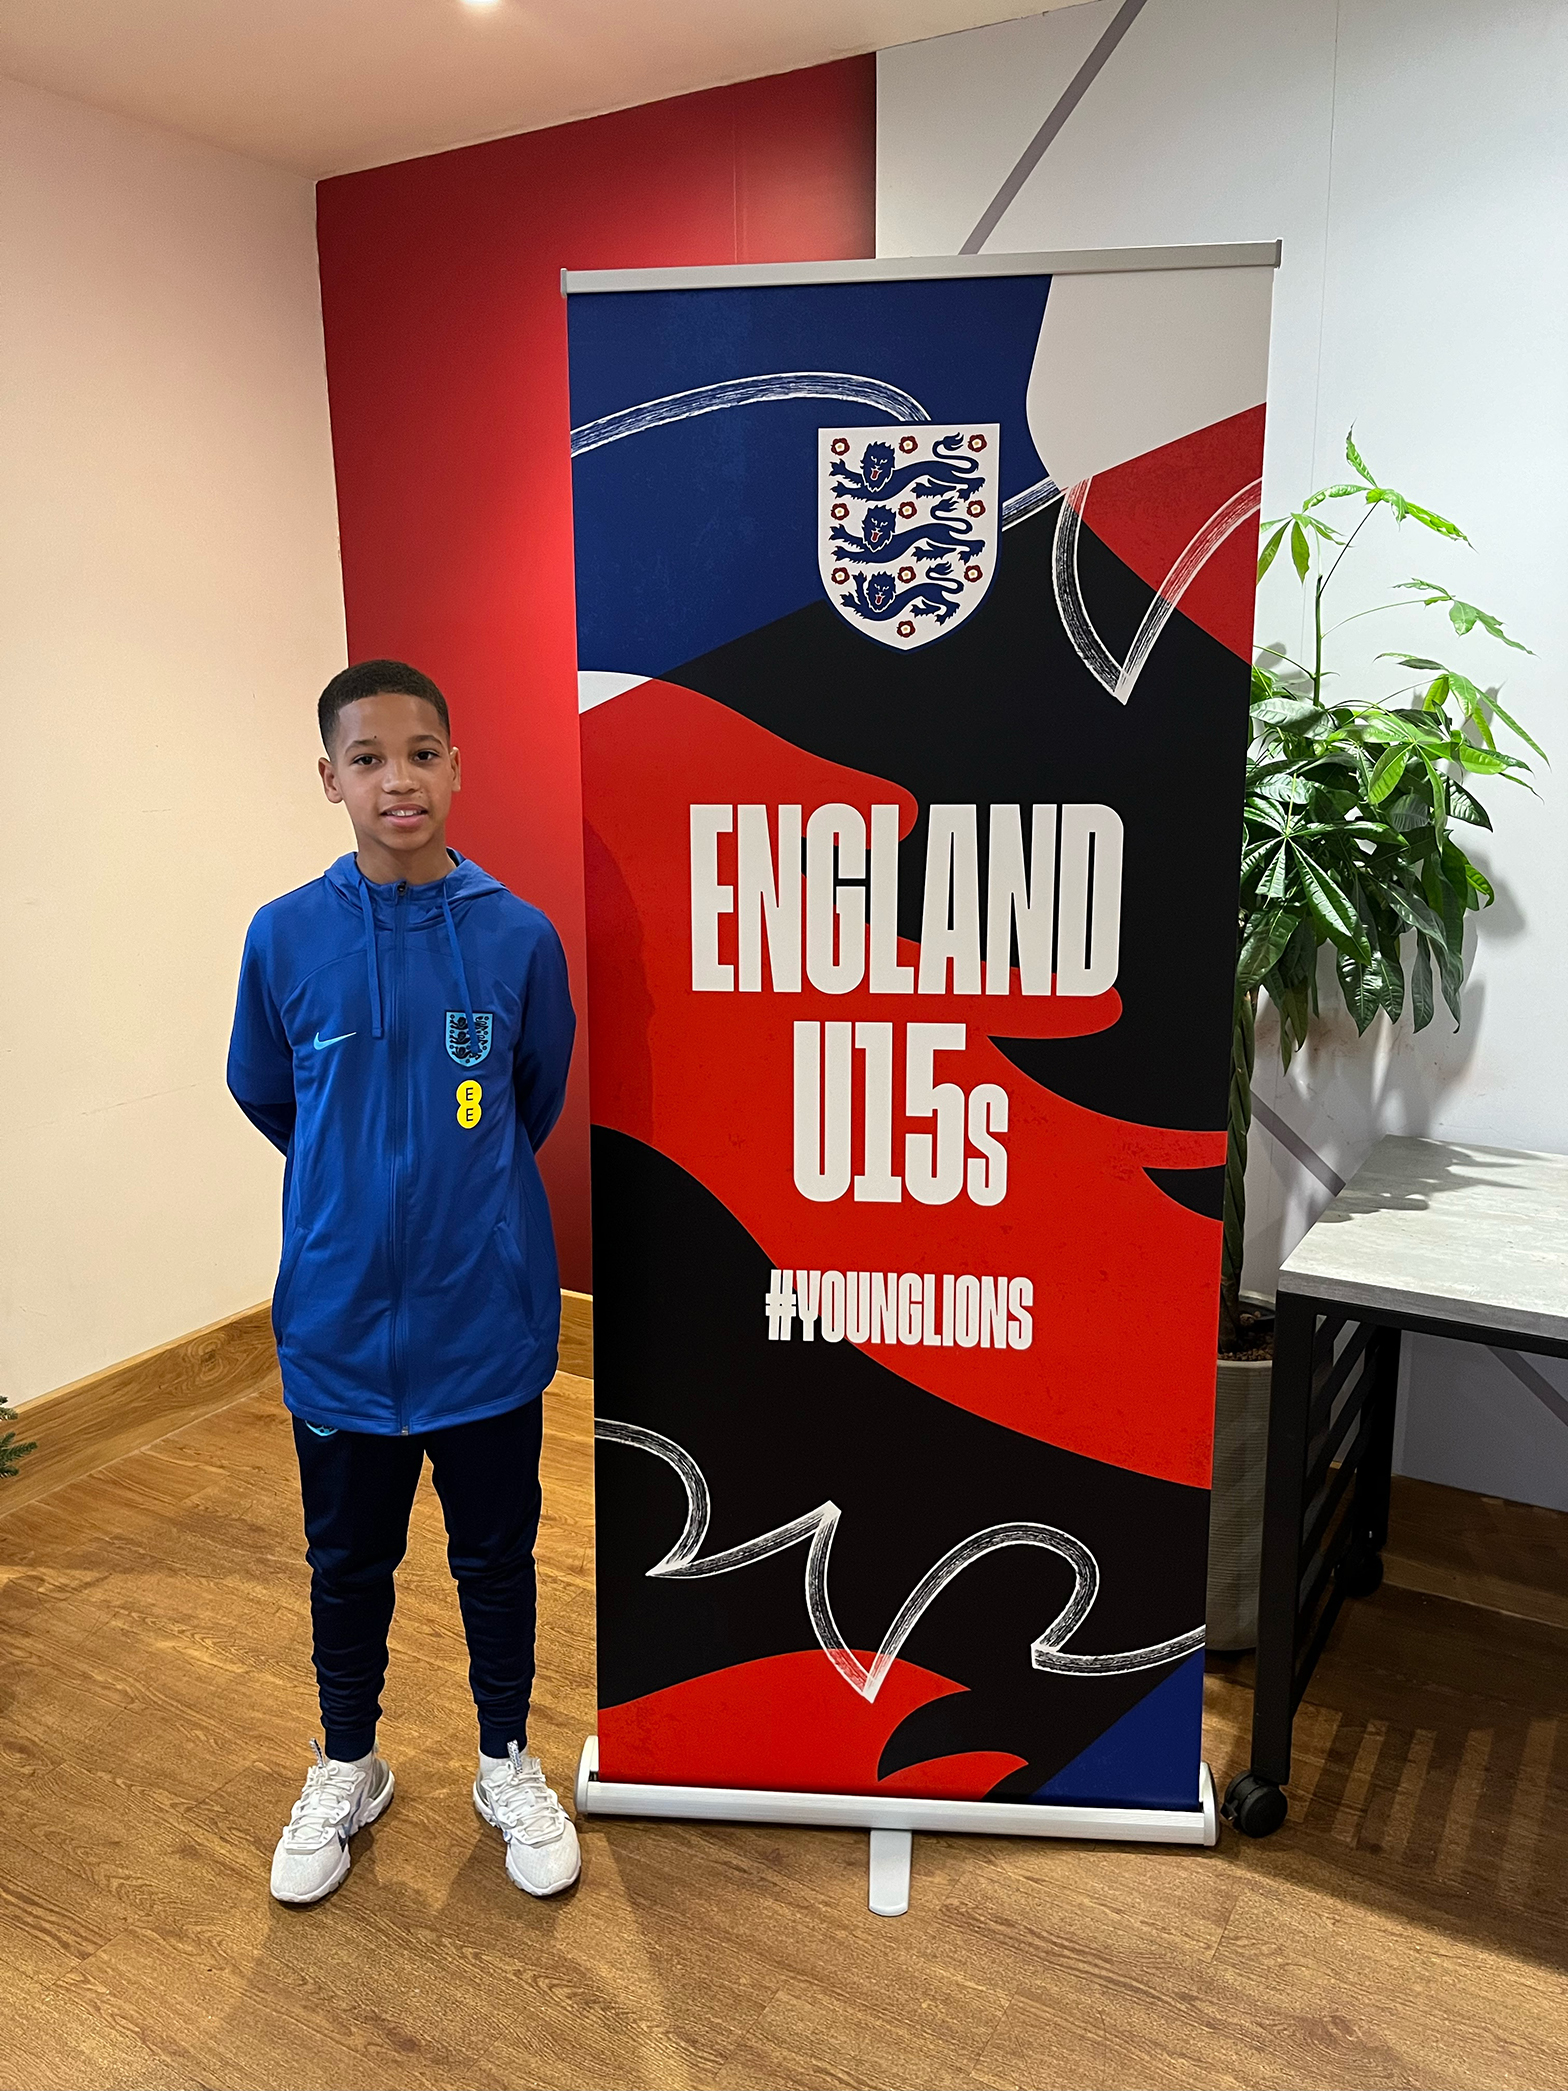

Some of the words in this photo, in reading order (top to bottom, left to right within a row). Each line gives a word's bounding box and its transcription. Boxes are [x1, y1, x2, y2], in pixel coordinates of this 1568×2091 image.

[689, 802, 1124, 997] ENGLAND
[793, 1020, 1009, 1207] U15s
[765, 1269, 1033, 1351] #YOUNGLIONS
